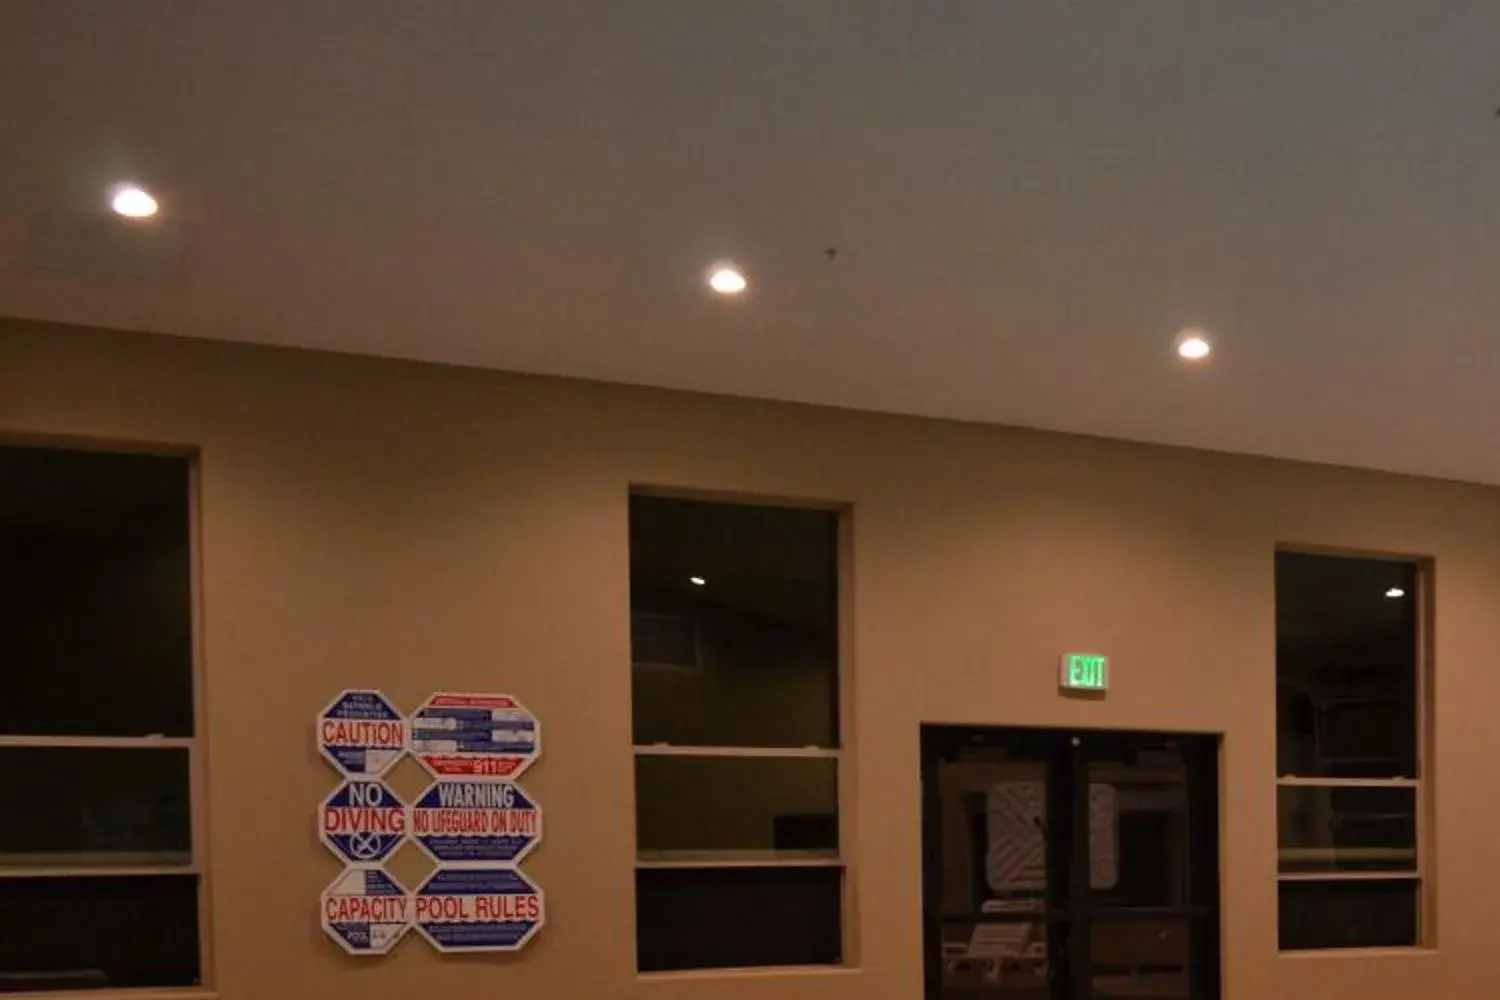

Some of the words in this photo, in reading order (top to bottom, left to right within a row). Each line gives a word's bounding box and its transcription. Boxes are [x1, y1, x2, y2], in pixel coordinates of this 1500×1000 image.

[1071, 655, 1104, 687] EXIT
[323, 721, 403, 743] CAUTION
[473, 759, 498, 774] 911
[349, 783, 383, 807] NO
[440, 784, 514, 807] WARNING
[325, 809, 405, 832] DIVING
[413, 810, 429, 833] NO
[431, 810, 488, 833] LIFEGUARD
[492, 810, 507, 833] ON
[509, 810, 537, 833] DUTY
[326, 897, 406, 920] CAPACITY
[416, 896, 469, 919] POOL
[475, 895, 539, 919] RULES
